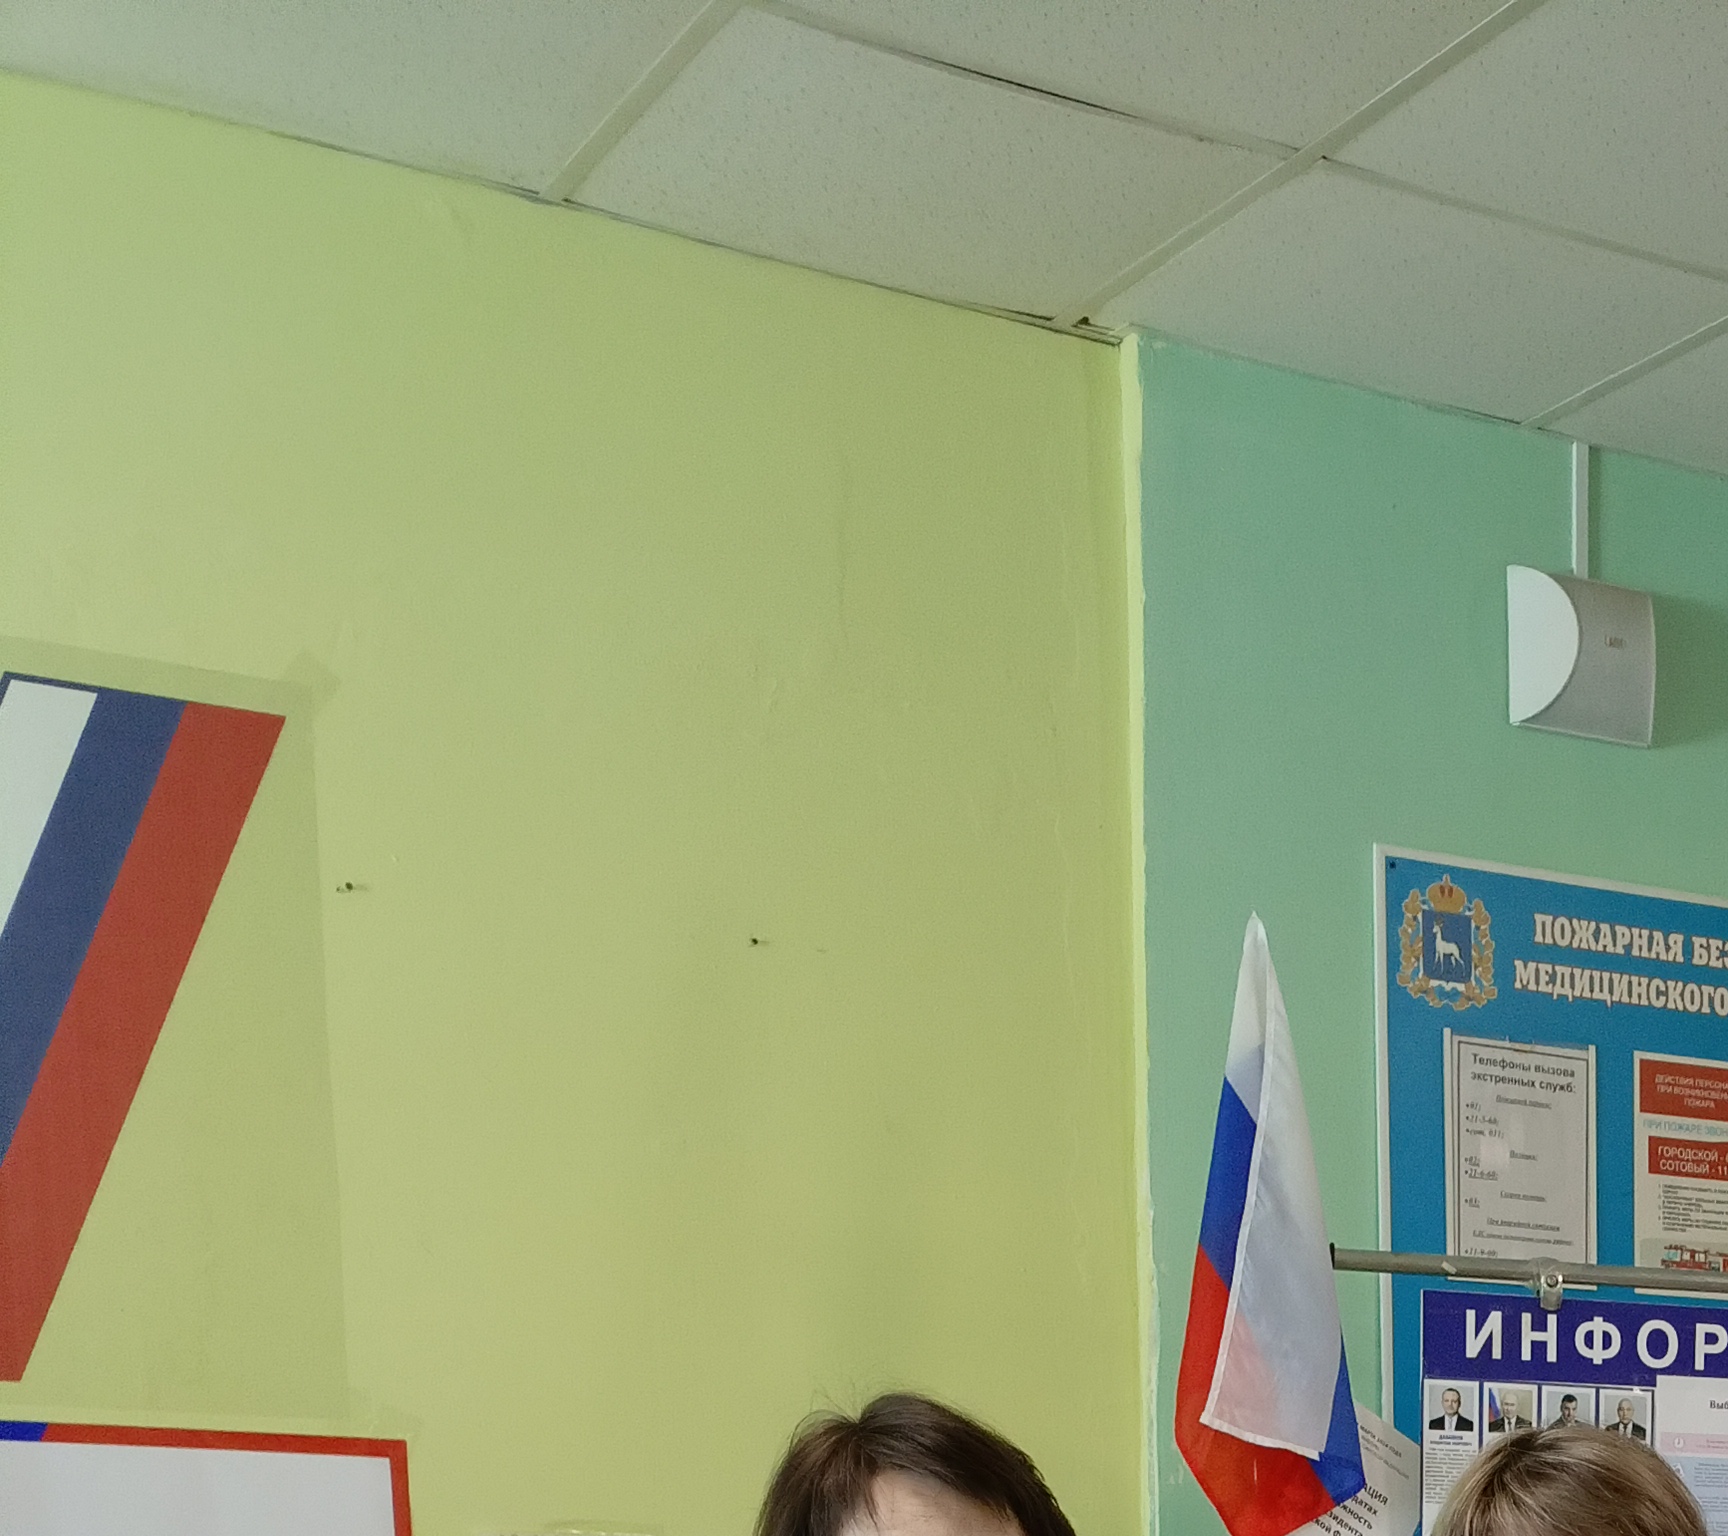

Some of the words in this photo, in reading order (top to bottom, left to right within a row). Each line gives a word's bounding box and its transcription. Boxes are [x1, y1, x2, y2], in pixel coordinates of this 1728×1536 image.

[1534, 913, 1684, 962] ПОЖАРНАЯ
[1471, 1053, 1531, 1071] Телефоны
[1534, 1065, 1575, 1078] вызова
[1471, 1072, 1536, 1089] экстренных
[1540, 1081, 1576, 1093] служб:
[1657, 1085, 1672, 1093] ПРИ
[1684, 1099, 1715, 1109] ПОЖАРА
[1664, 1121, 1703, 1134] ПОЖАРЕ
[1658, 1146, 1718, 1162] ГОРОДСКОЙ
[1660, 1160, 1709, 1174] СОТОВЫЙ
[1351, 1495, 1379, 1517] датах
[1338, 1502, 1373, 1531] жность
